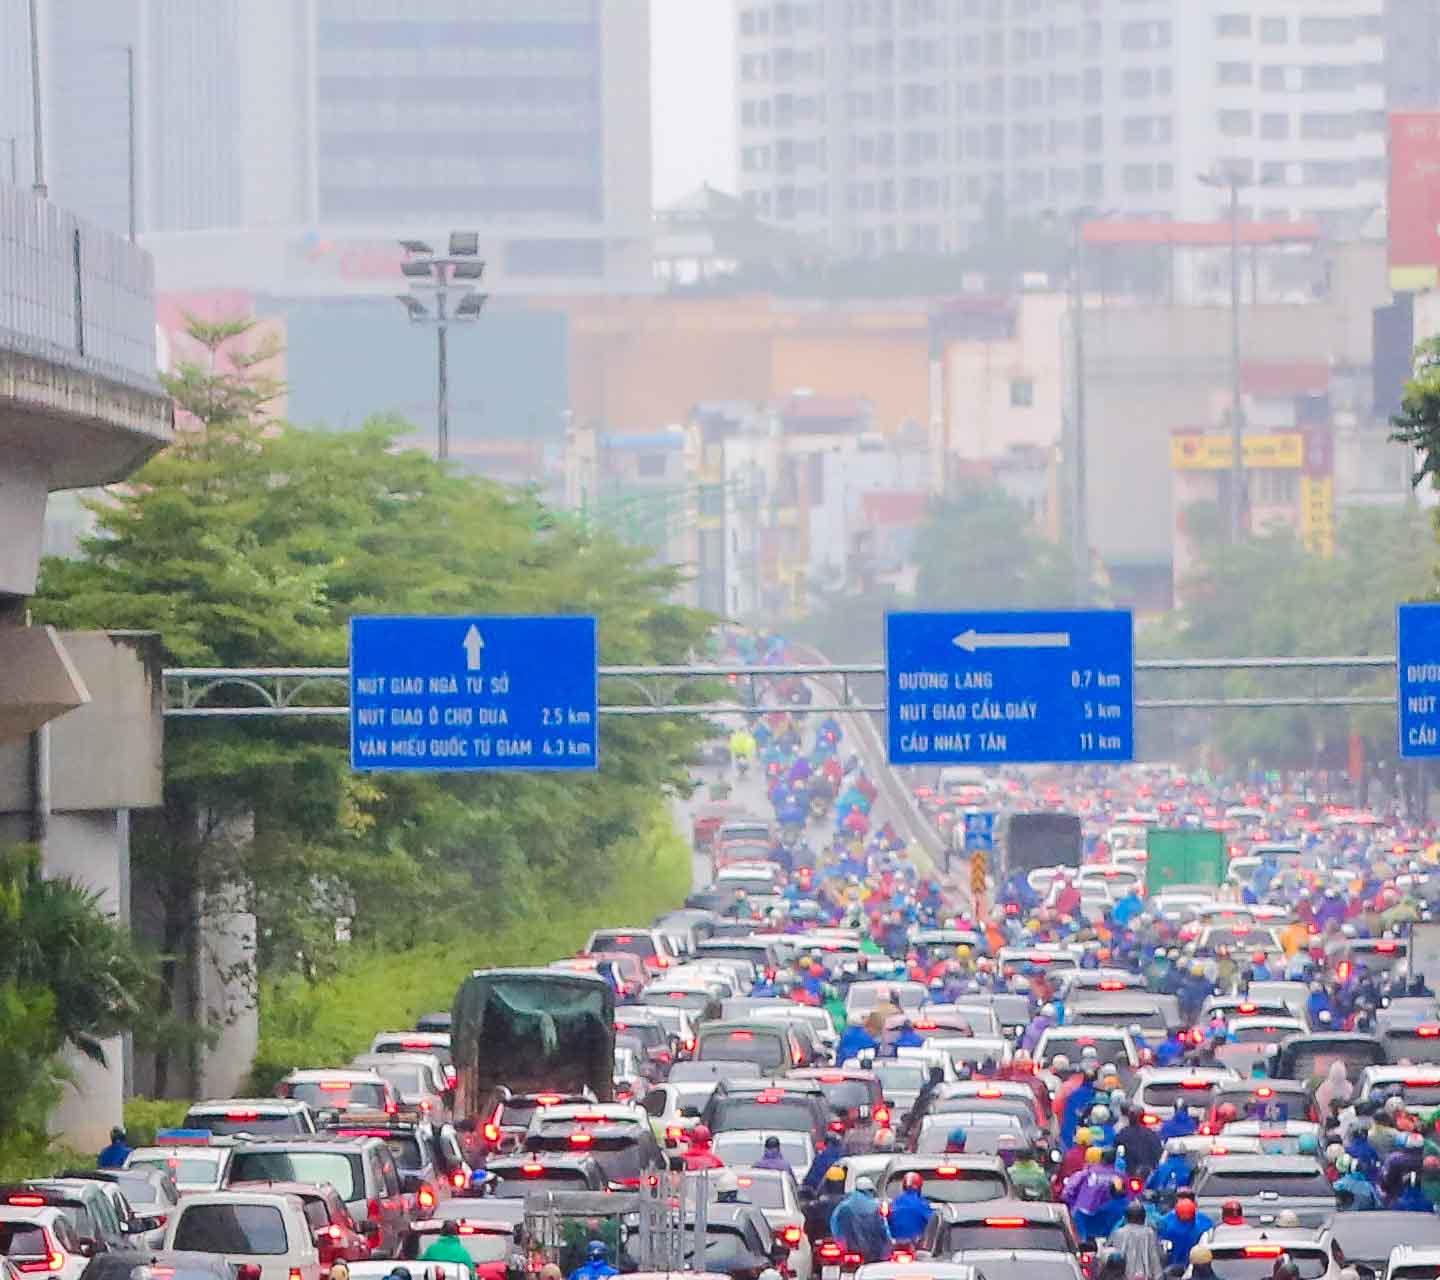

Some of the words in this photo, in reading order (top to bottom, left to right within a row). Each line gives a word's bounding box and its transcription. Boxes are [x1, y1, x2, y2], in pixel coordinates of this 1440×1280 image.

[1071, 671, 1090, 688] 0.7
[1097, 672, 1121, 687] km
[569, 708, 590, 724] km
[1098, 703, 1120, 719] km
[568, 741, 590, 755] km
[1098, 734, 1121, 749] km
